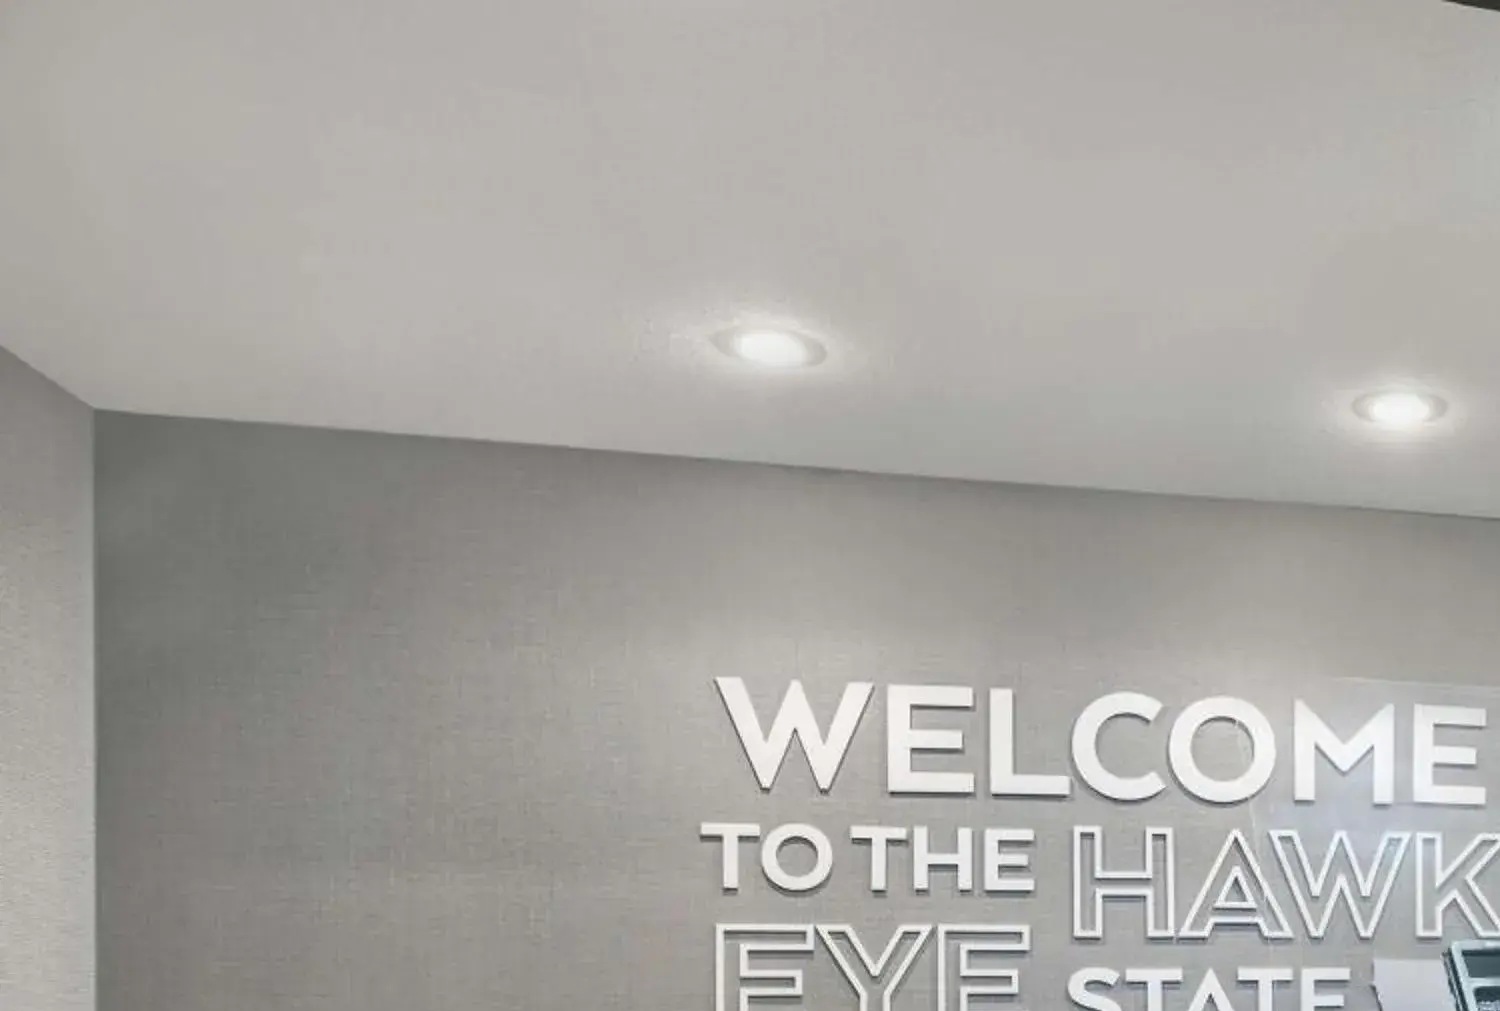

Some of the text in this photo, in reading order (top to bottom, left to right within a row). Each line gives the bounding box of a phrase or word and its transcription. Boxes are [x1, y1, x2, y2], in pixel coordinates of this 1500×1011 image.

[714, 676, 1487, 805] WELCOME
[700, 821, 833, 892] TO
[850, 825, 1036, 893] THE
